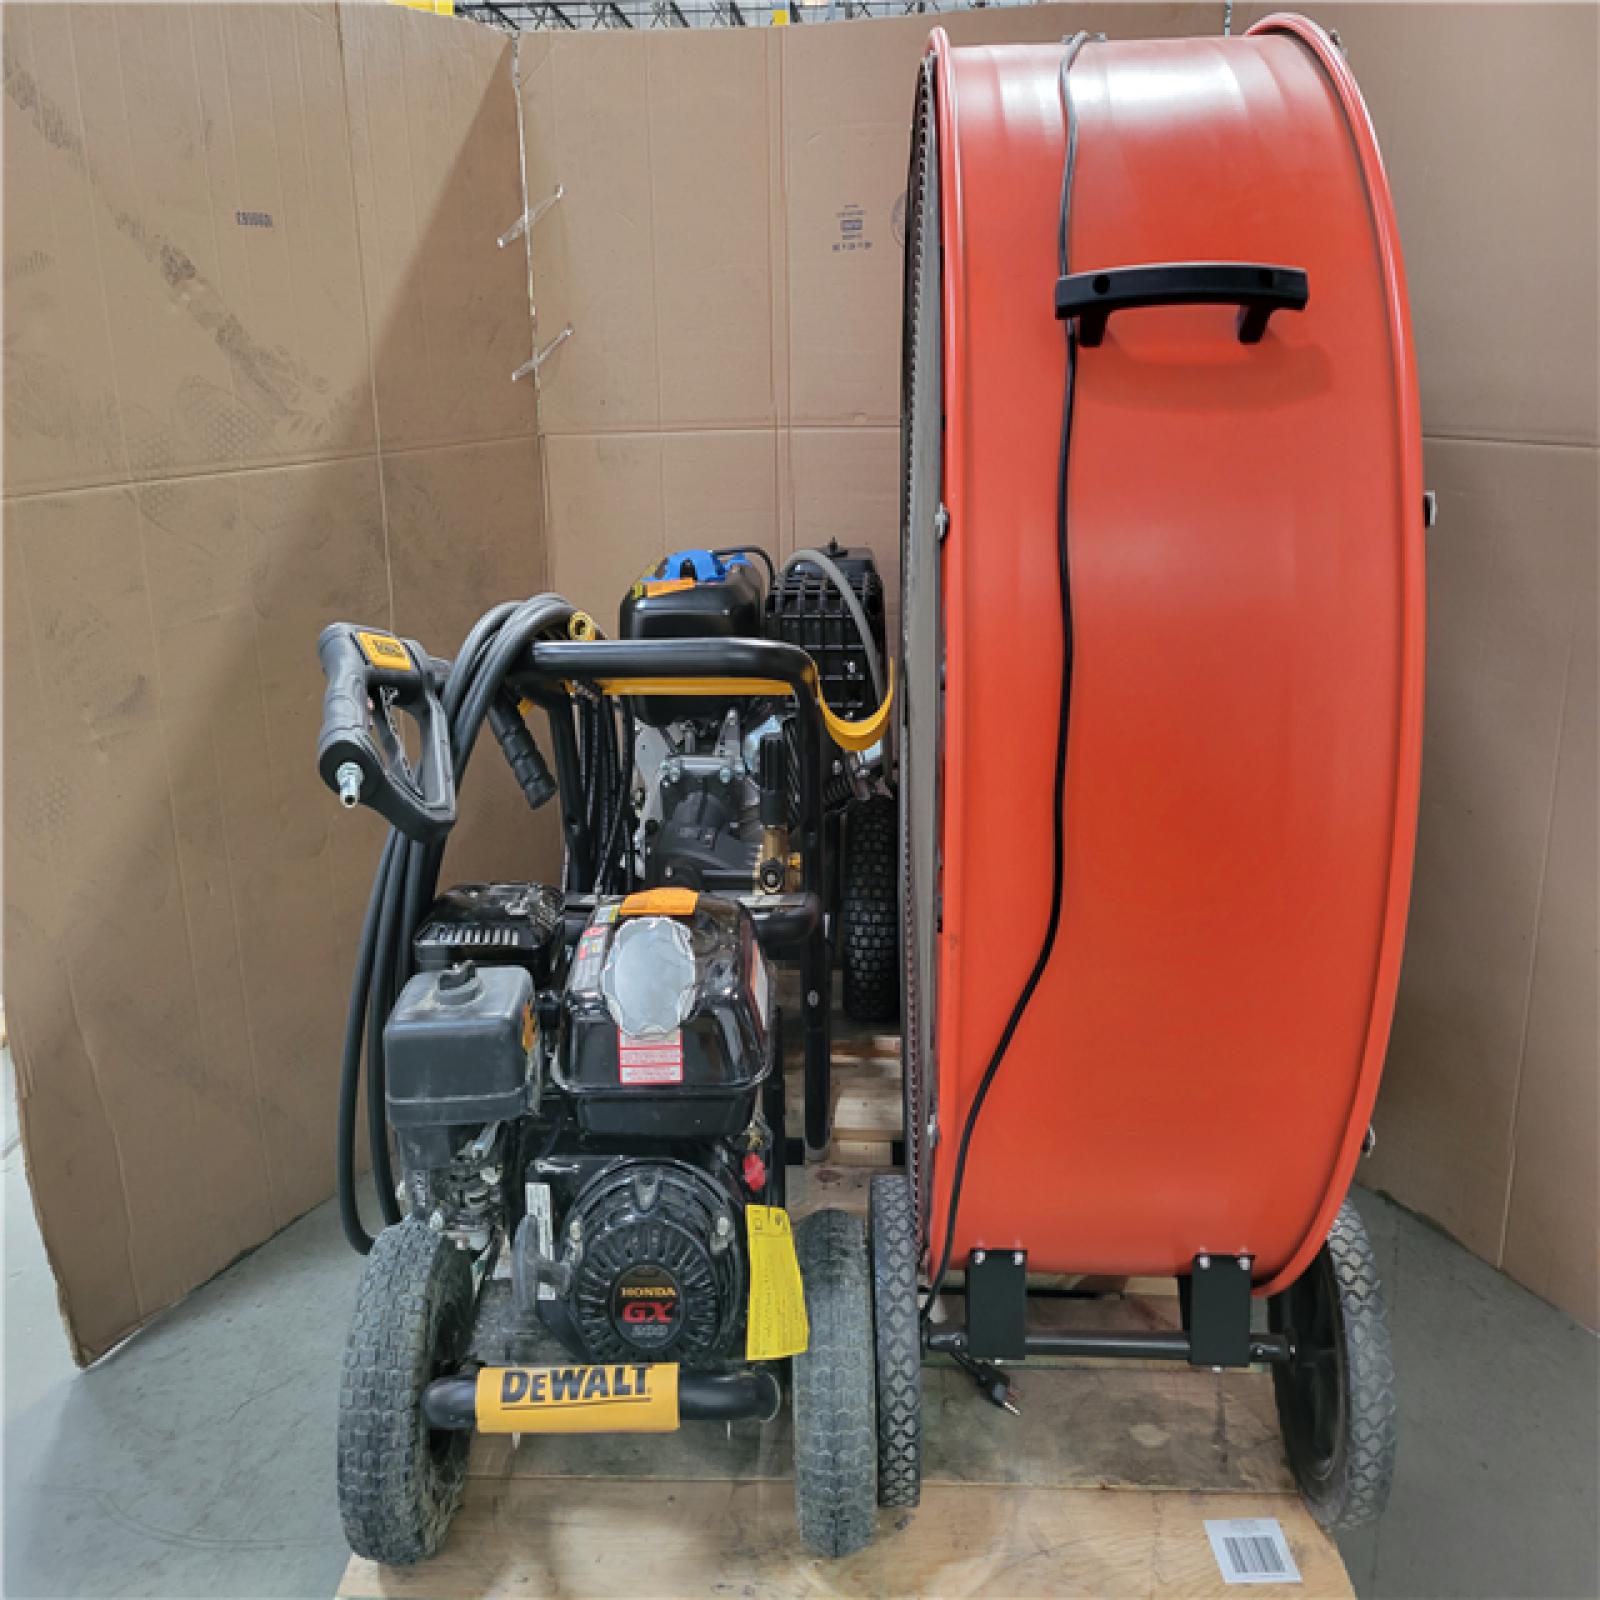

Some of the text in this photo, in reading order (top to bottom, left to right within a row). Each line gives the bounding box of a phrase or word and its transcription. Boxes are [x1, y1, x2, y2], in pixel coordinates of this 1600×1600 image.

[621, 1286, 676, 1297] HONDA
[622, 1301, 673, 1323] GX
[501, 1364, 652, 1403] DEWALT
